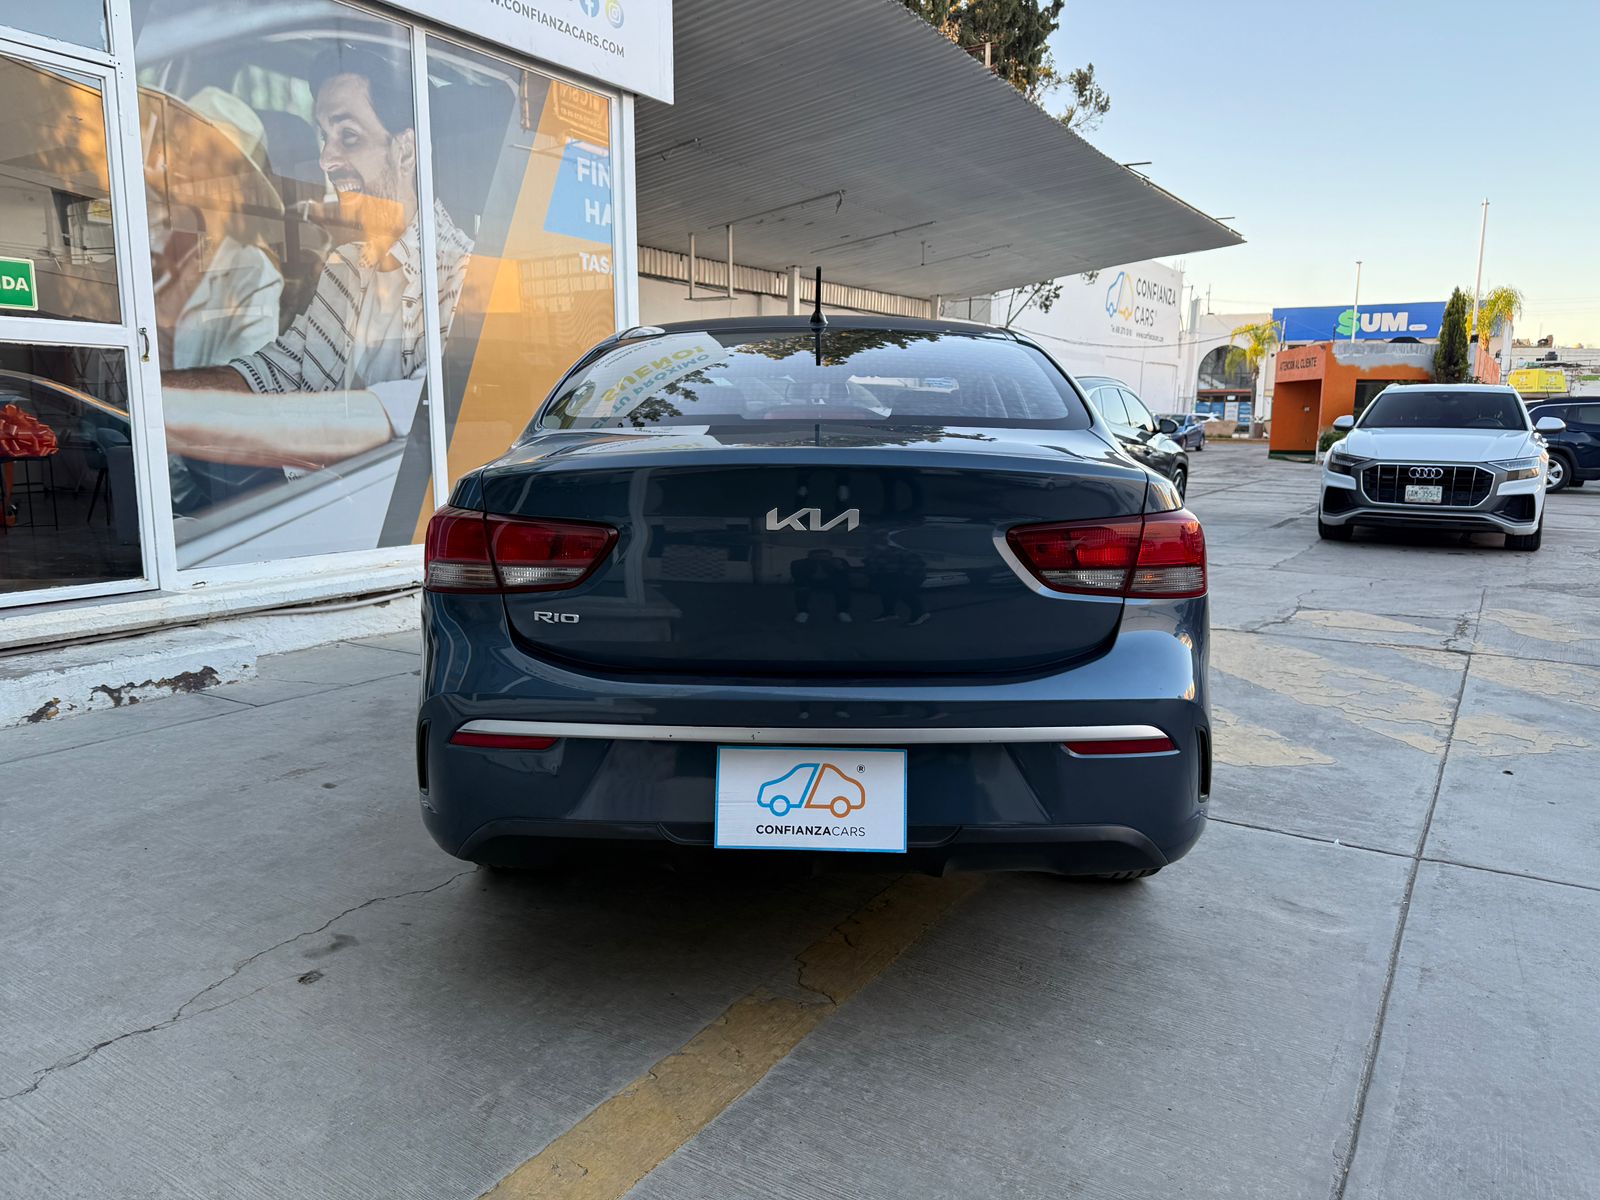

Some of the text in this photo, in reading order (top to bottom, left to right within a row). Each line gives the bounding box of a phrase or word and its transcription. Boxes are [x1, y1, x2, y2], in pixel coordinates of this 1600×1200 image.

[579, 251, 614, 275] TAS
[0, 275, 30, 292] DA
[1136, 277, 1176, 307] CONFIANZA
[1135, 305, 1154, 327] CARS
[766, 507, 860, 532] KIA
[533, 610, 580, 624] RIO
